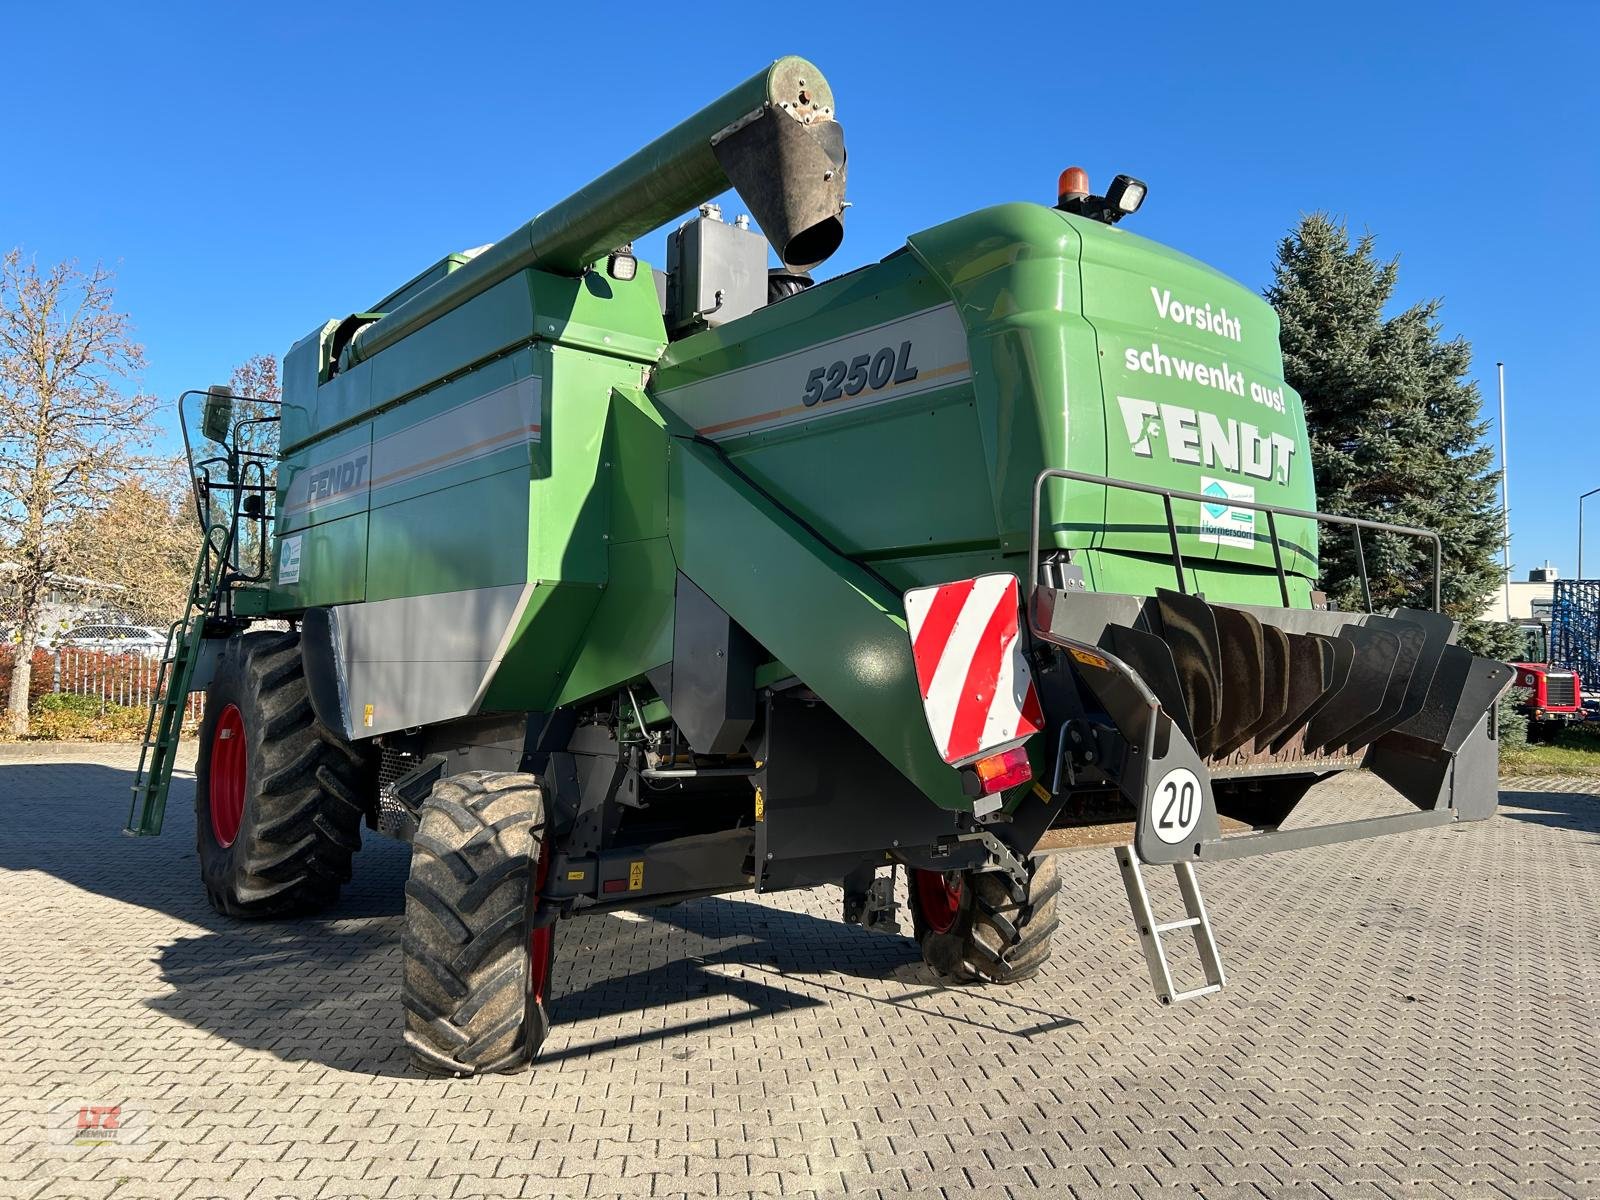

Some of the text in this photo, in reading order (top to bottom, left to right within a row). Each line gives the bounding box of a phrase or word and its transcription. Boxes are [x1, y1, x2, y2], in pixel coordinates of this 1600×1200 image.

[1150, 286, 1241, 341] Vorsicht
[802, 340, 918, 407] 5250L
[1125, 344, 1286, 414] schwenkt aus!
[1116, 396, 1295, 486] FENDT
[307, 455, 368, 503] FENDT
[1158, 781, 1195, 829] 20
